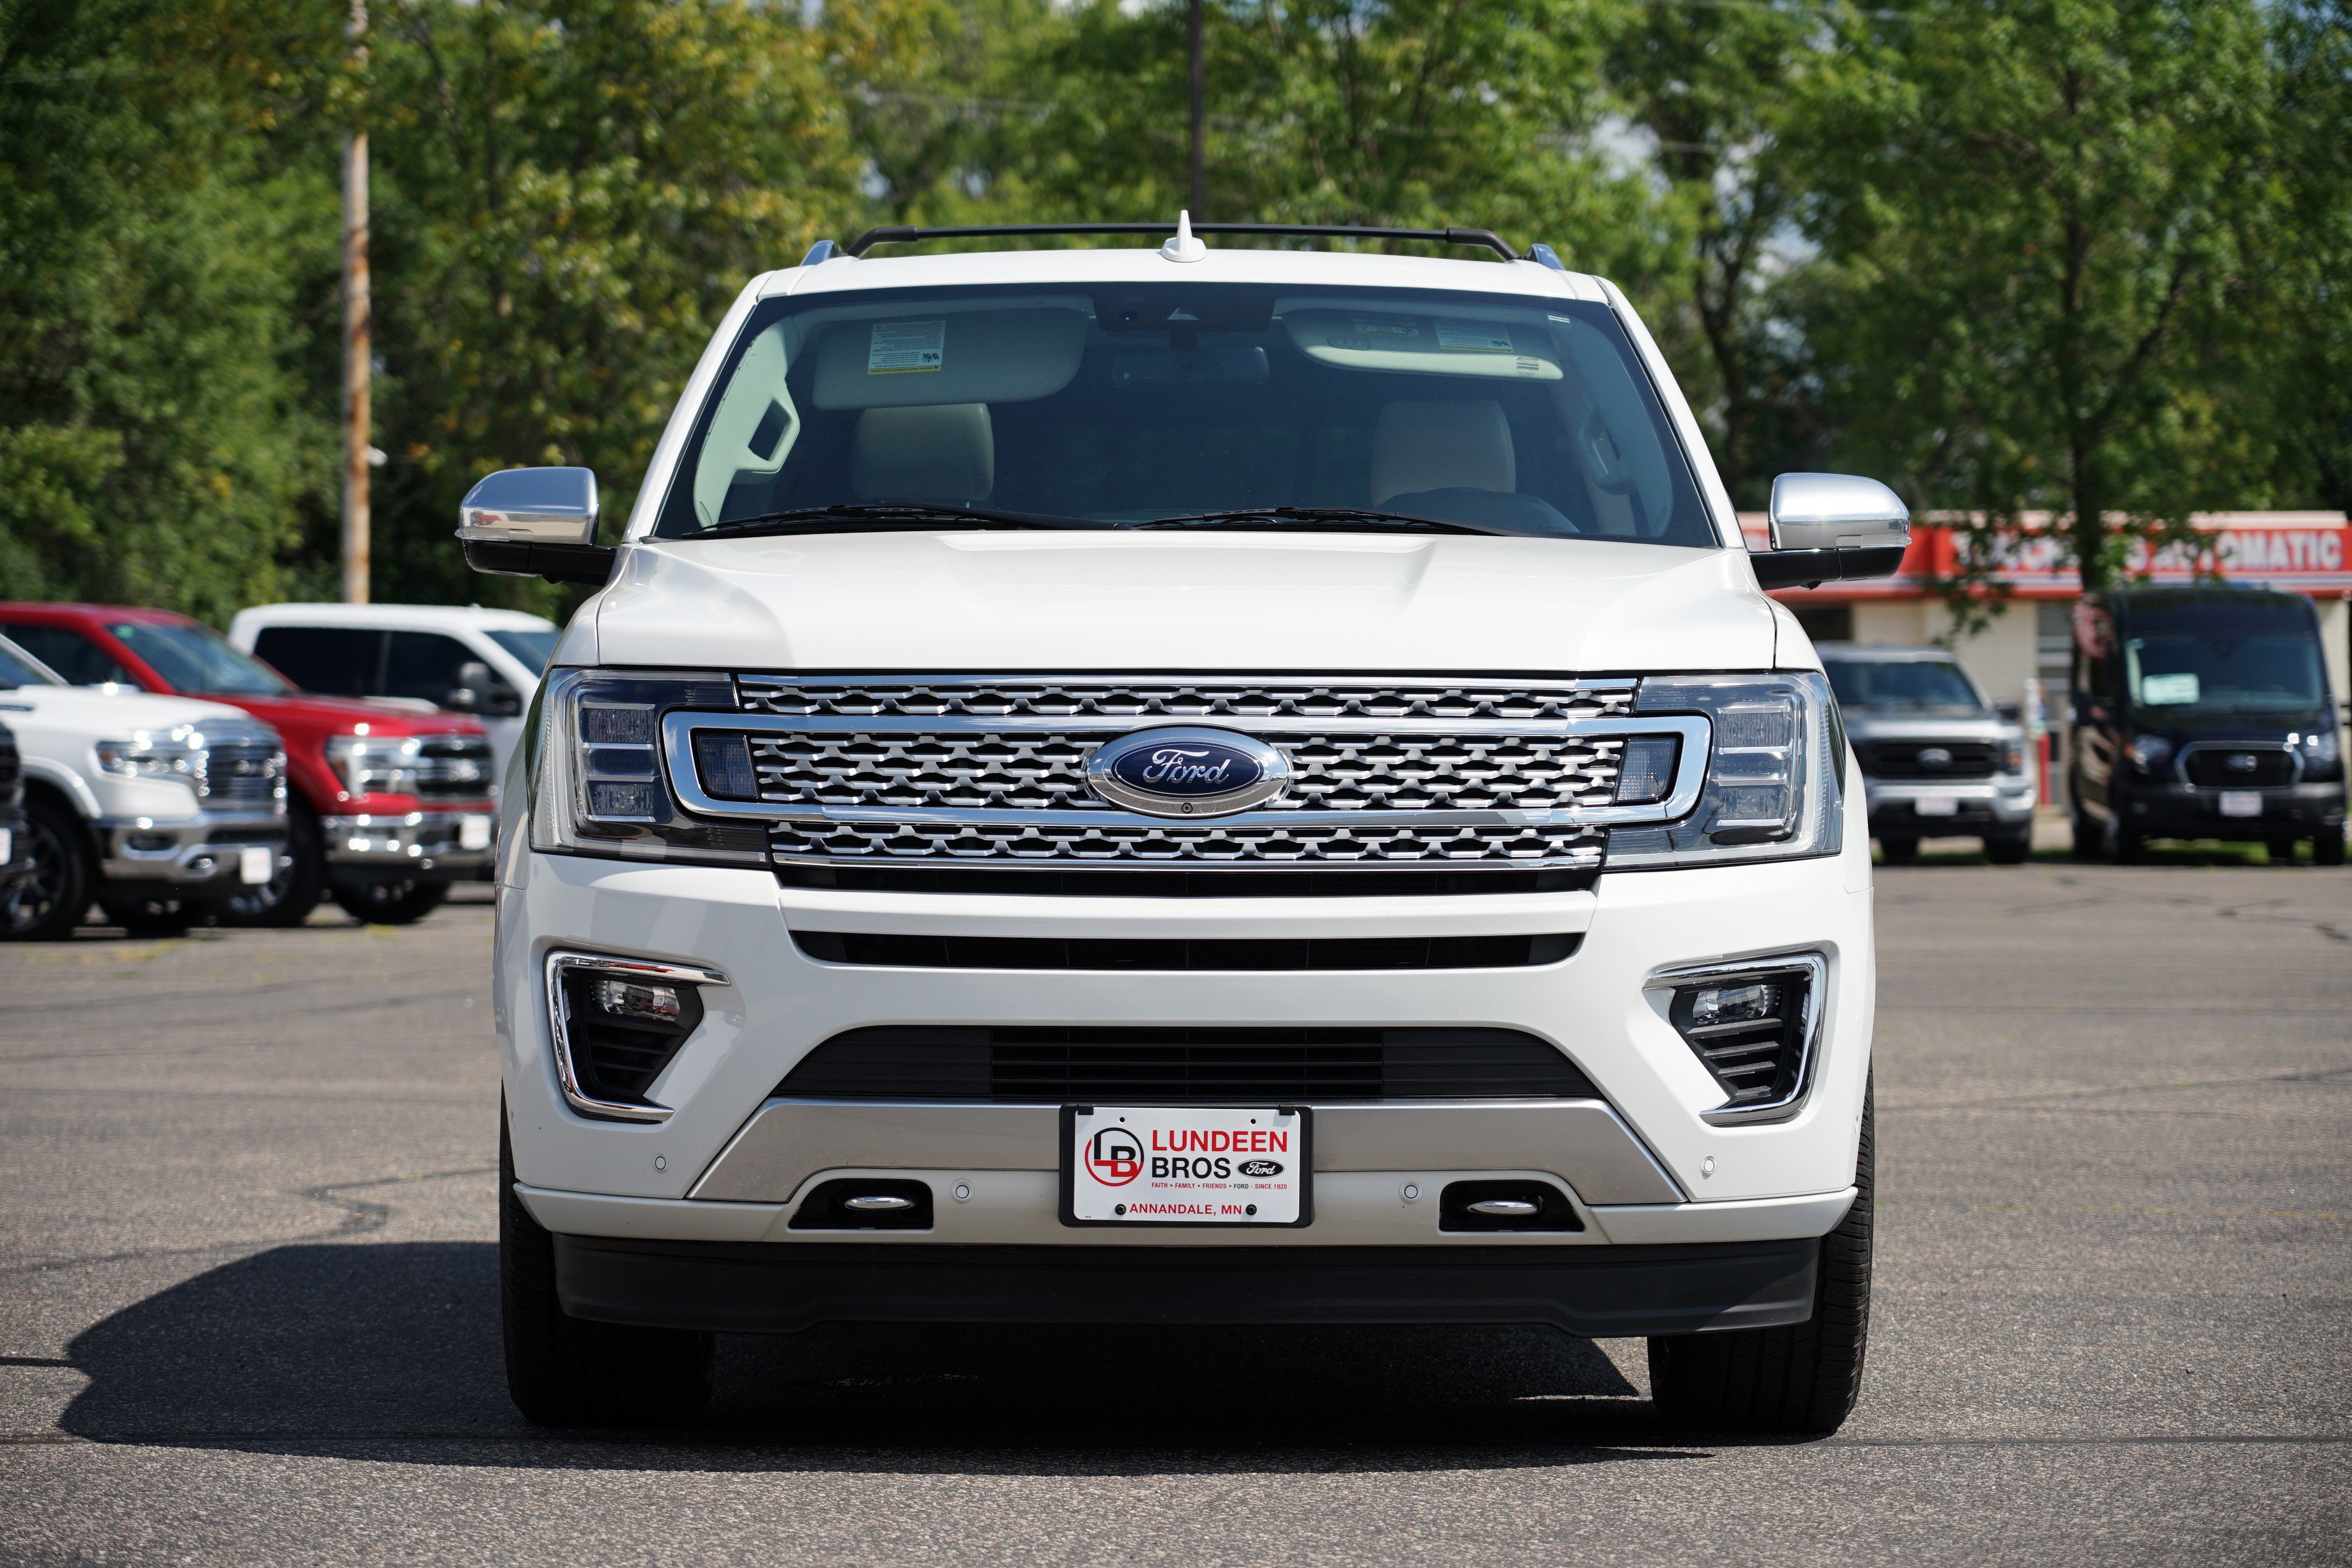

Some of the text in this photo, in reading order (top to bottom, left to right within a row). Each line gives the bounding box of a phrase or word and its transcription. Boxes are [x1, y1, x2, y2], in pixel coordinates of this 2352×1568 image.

[1143, 749, 1231, 783] Ford
[1152, 1130, 1288, 1152] LUNDEEN
[1152, 1157, 1231, 1179] BROS
[1246, 1162, 1276, 1175] Ford
[1129, 1203, 1242, 1216] ANNANDALE, MN
